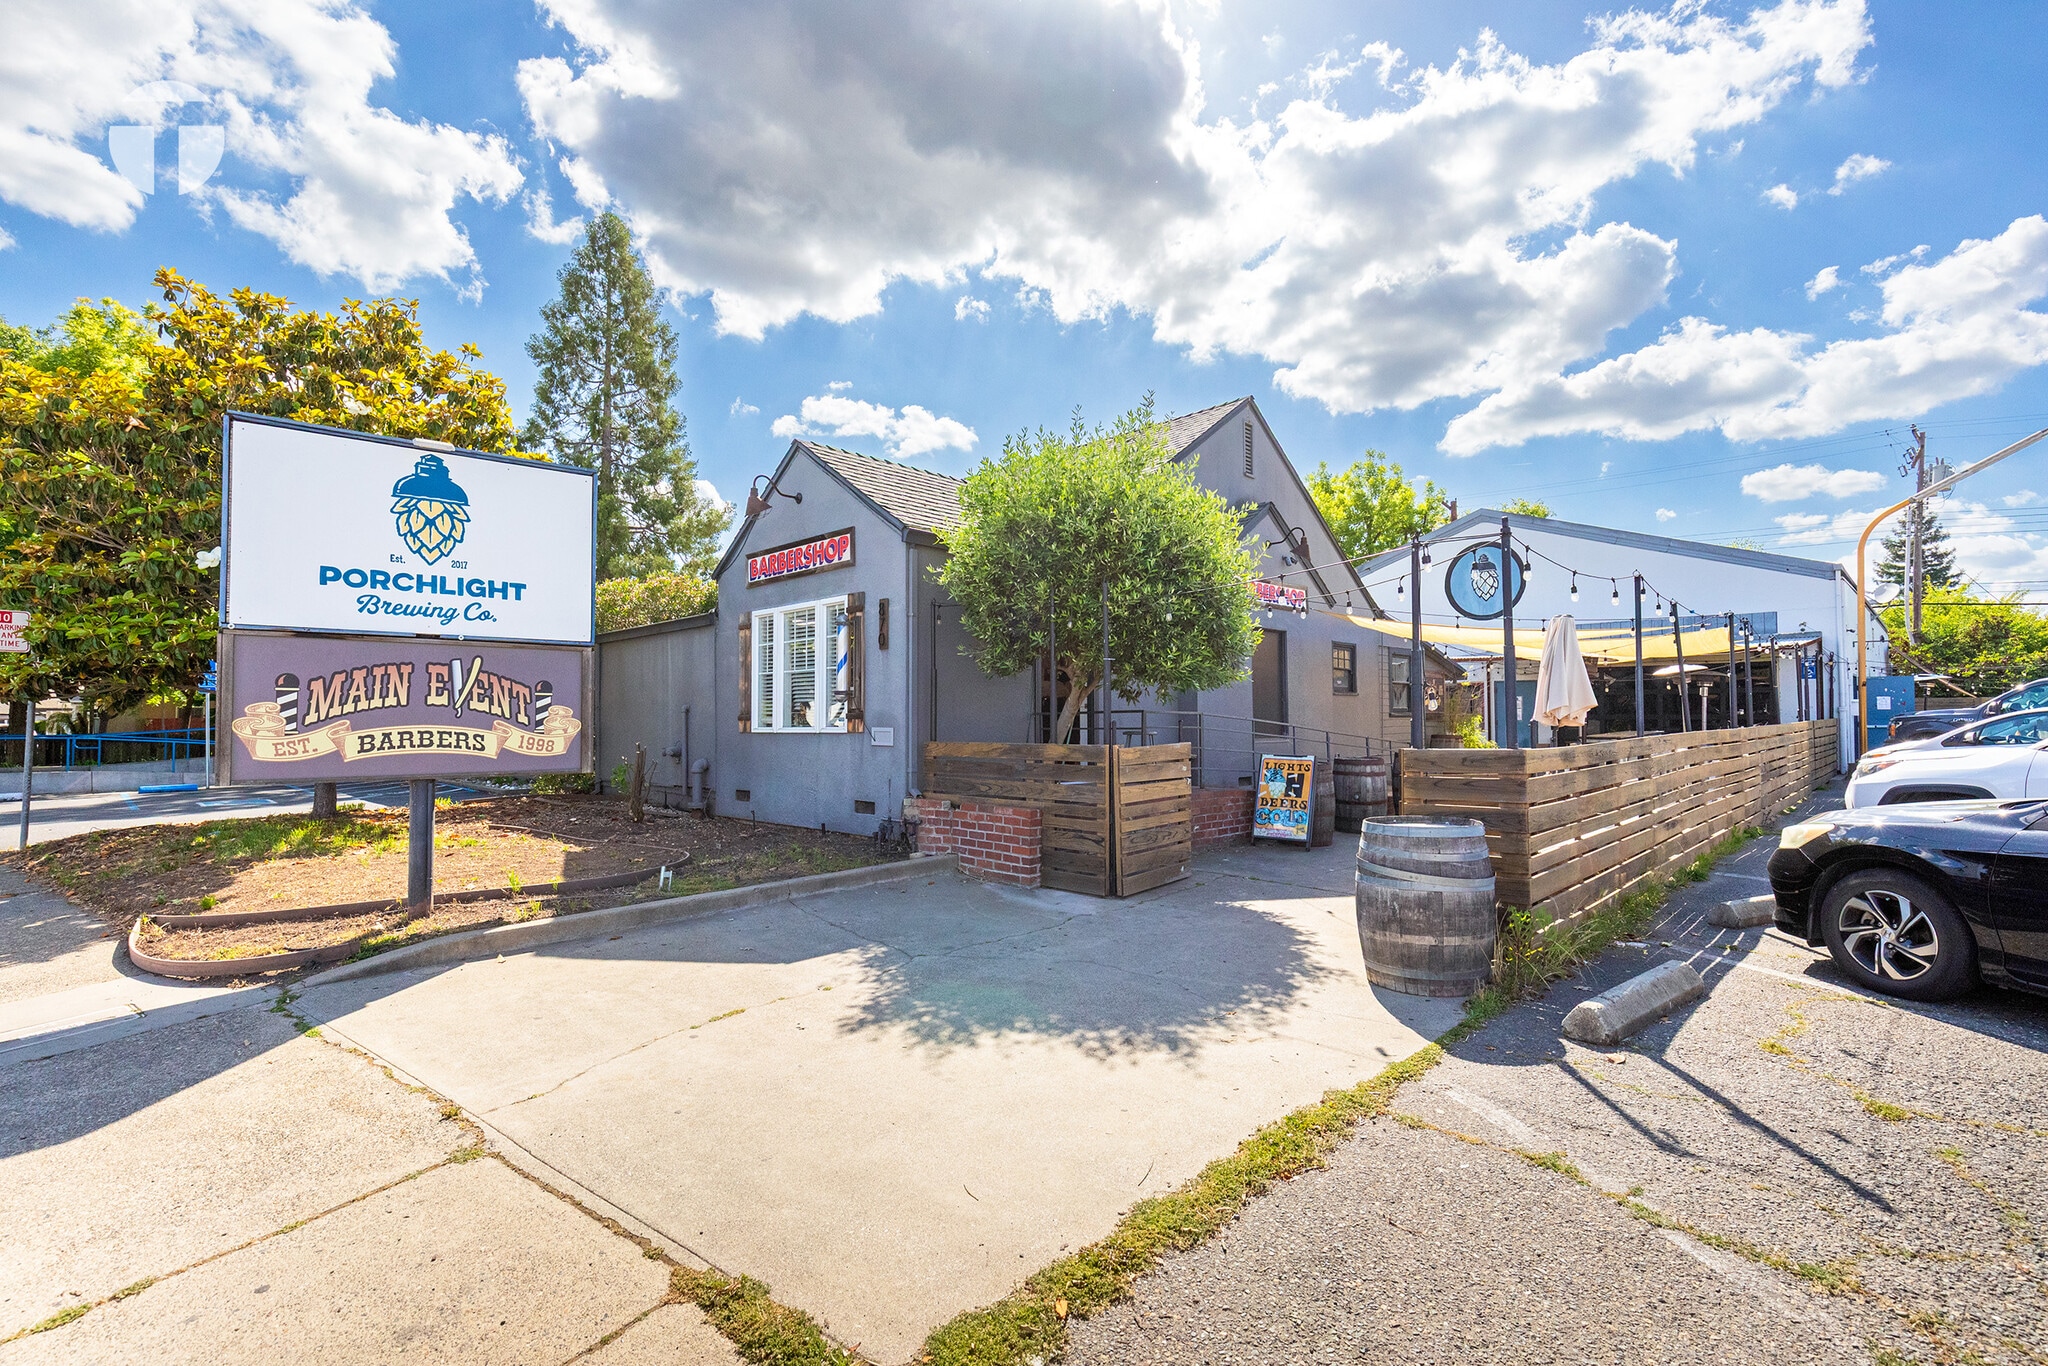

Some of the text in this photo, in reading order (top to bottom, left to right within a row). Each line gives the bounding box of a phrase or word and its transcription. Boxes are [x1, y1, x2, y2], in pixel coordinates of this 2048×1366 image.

[390, 554, 468, 569] Est. 2017
[750, 535, 850, 581] BARBERSHOP
[319, 565, 527, 601] PORCHLIGHT
[0, 613, 10, 622] O
[356, 594, 497, 625] Brewing Co.
[878, 602, 886, 646] 870
[304, 662, 415, 726] MAIN
[272, 730, 555, 757] EST. BARBERS 1998
[1264, 762, 1311, 772] LIGHTS
[1260, 797, 1307, 810] BEERS
[1255, 808, 1307, 827] COLD
